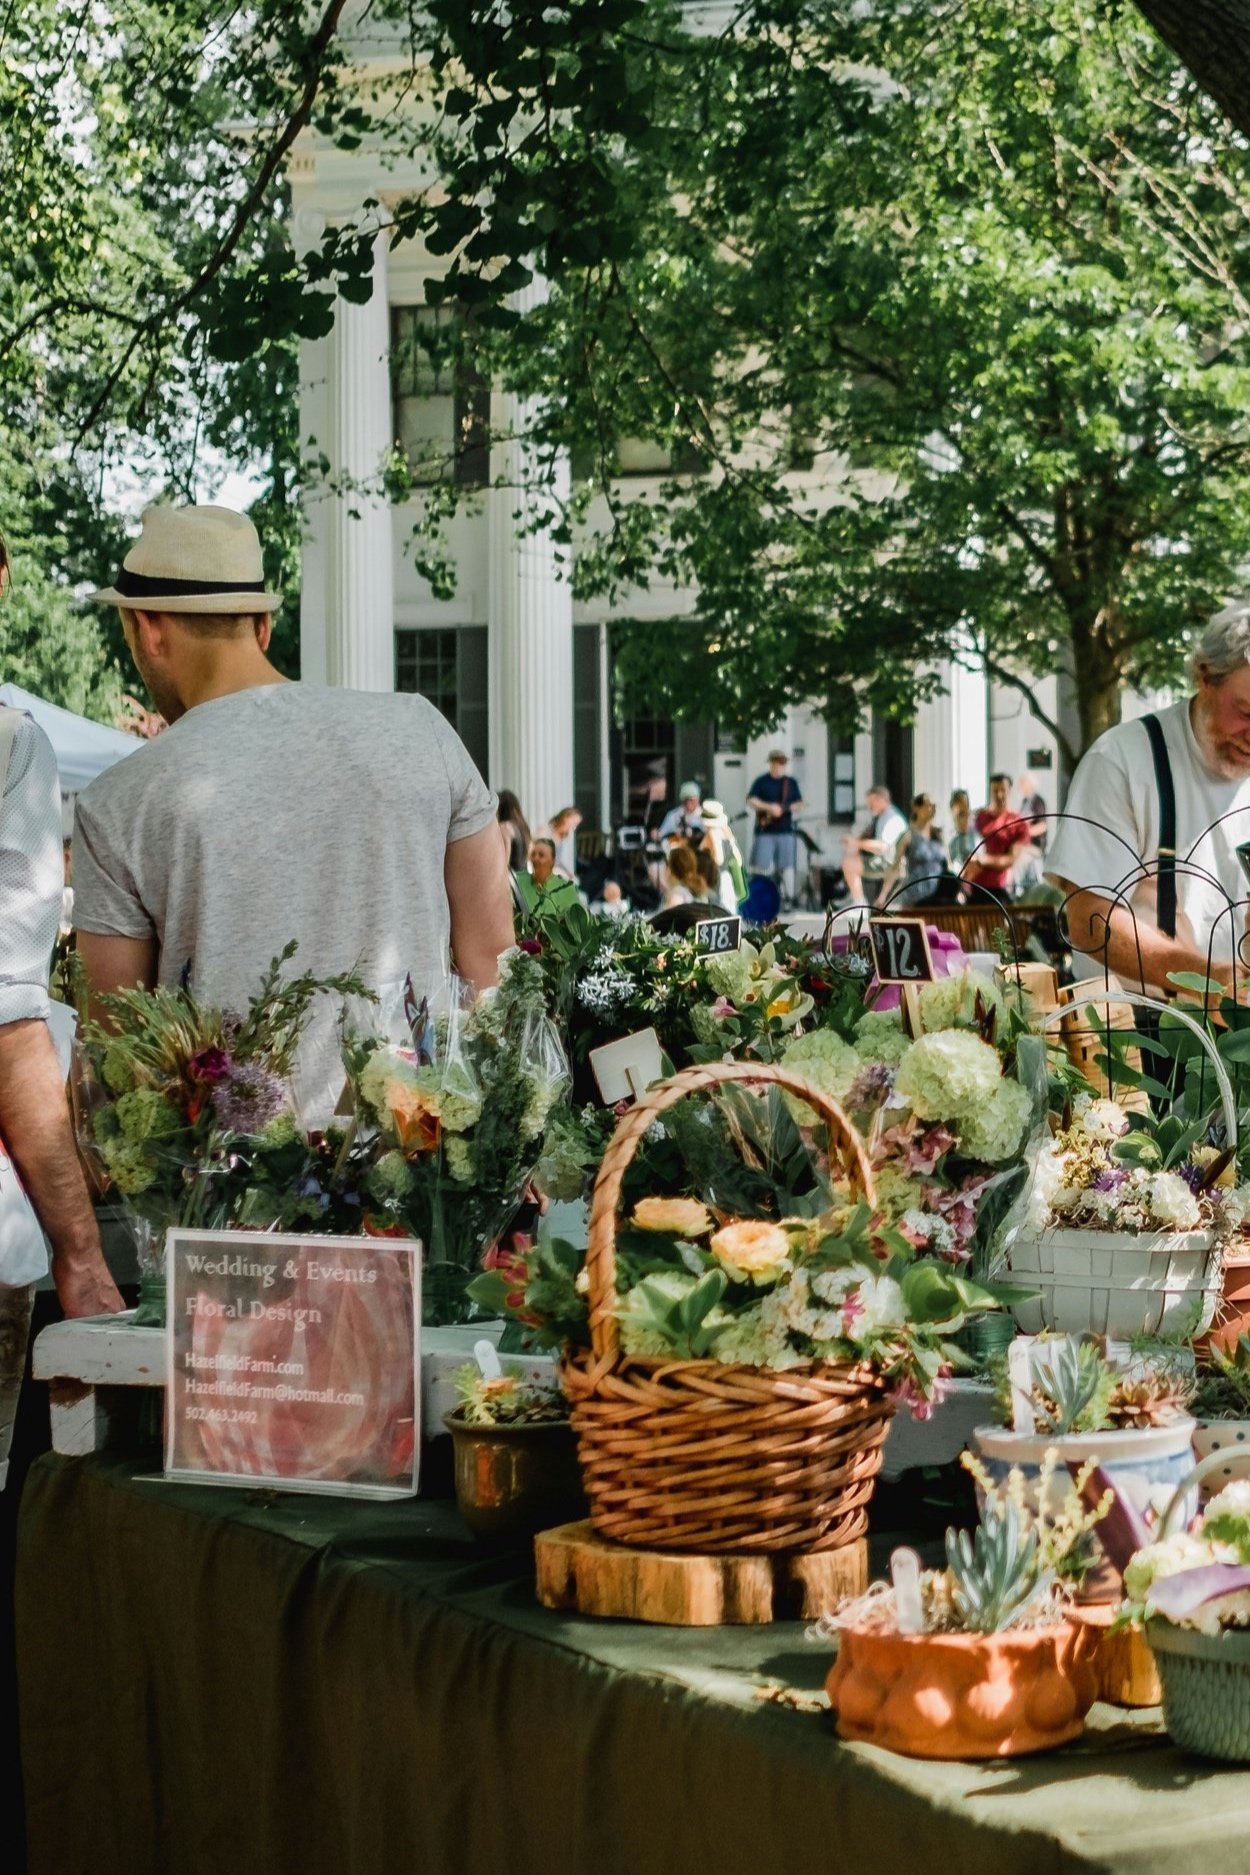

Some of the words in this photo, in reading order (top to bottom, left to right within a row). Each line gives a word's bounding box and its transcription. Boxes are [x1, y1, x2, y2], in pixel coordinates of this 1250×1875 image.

[185, 1255, 277, 1288] Wedding
[283, 1260, 298, 1280] &
[307, 1261, 377, 1284] Events
[185, 1297, 244, 1319] Floral
[250, 1300, 322, 1332] Design
[185, 1352, 304, 1375] HazelfieldFarm.com
[185, 1378, 365, 1406] HazelfieldFarm@hotmail.com
